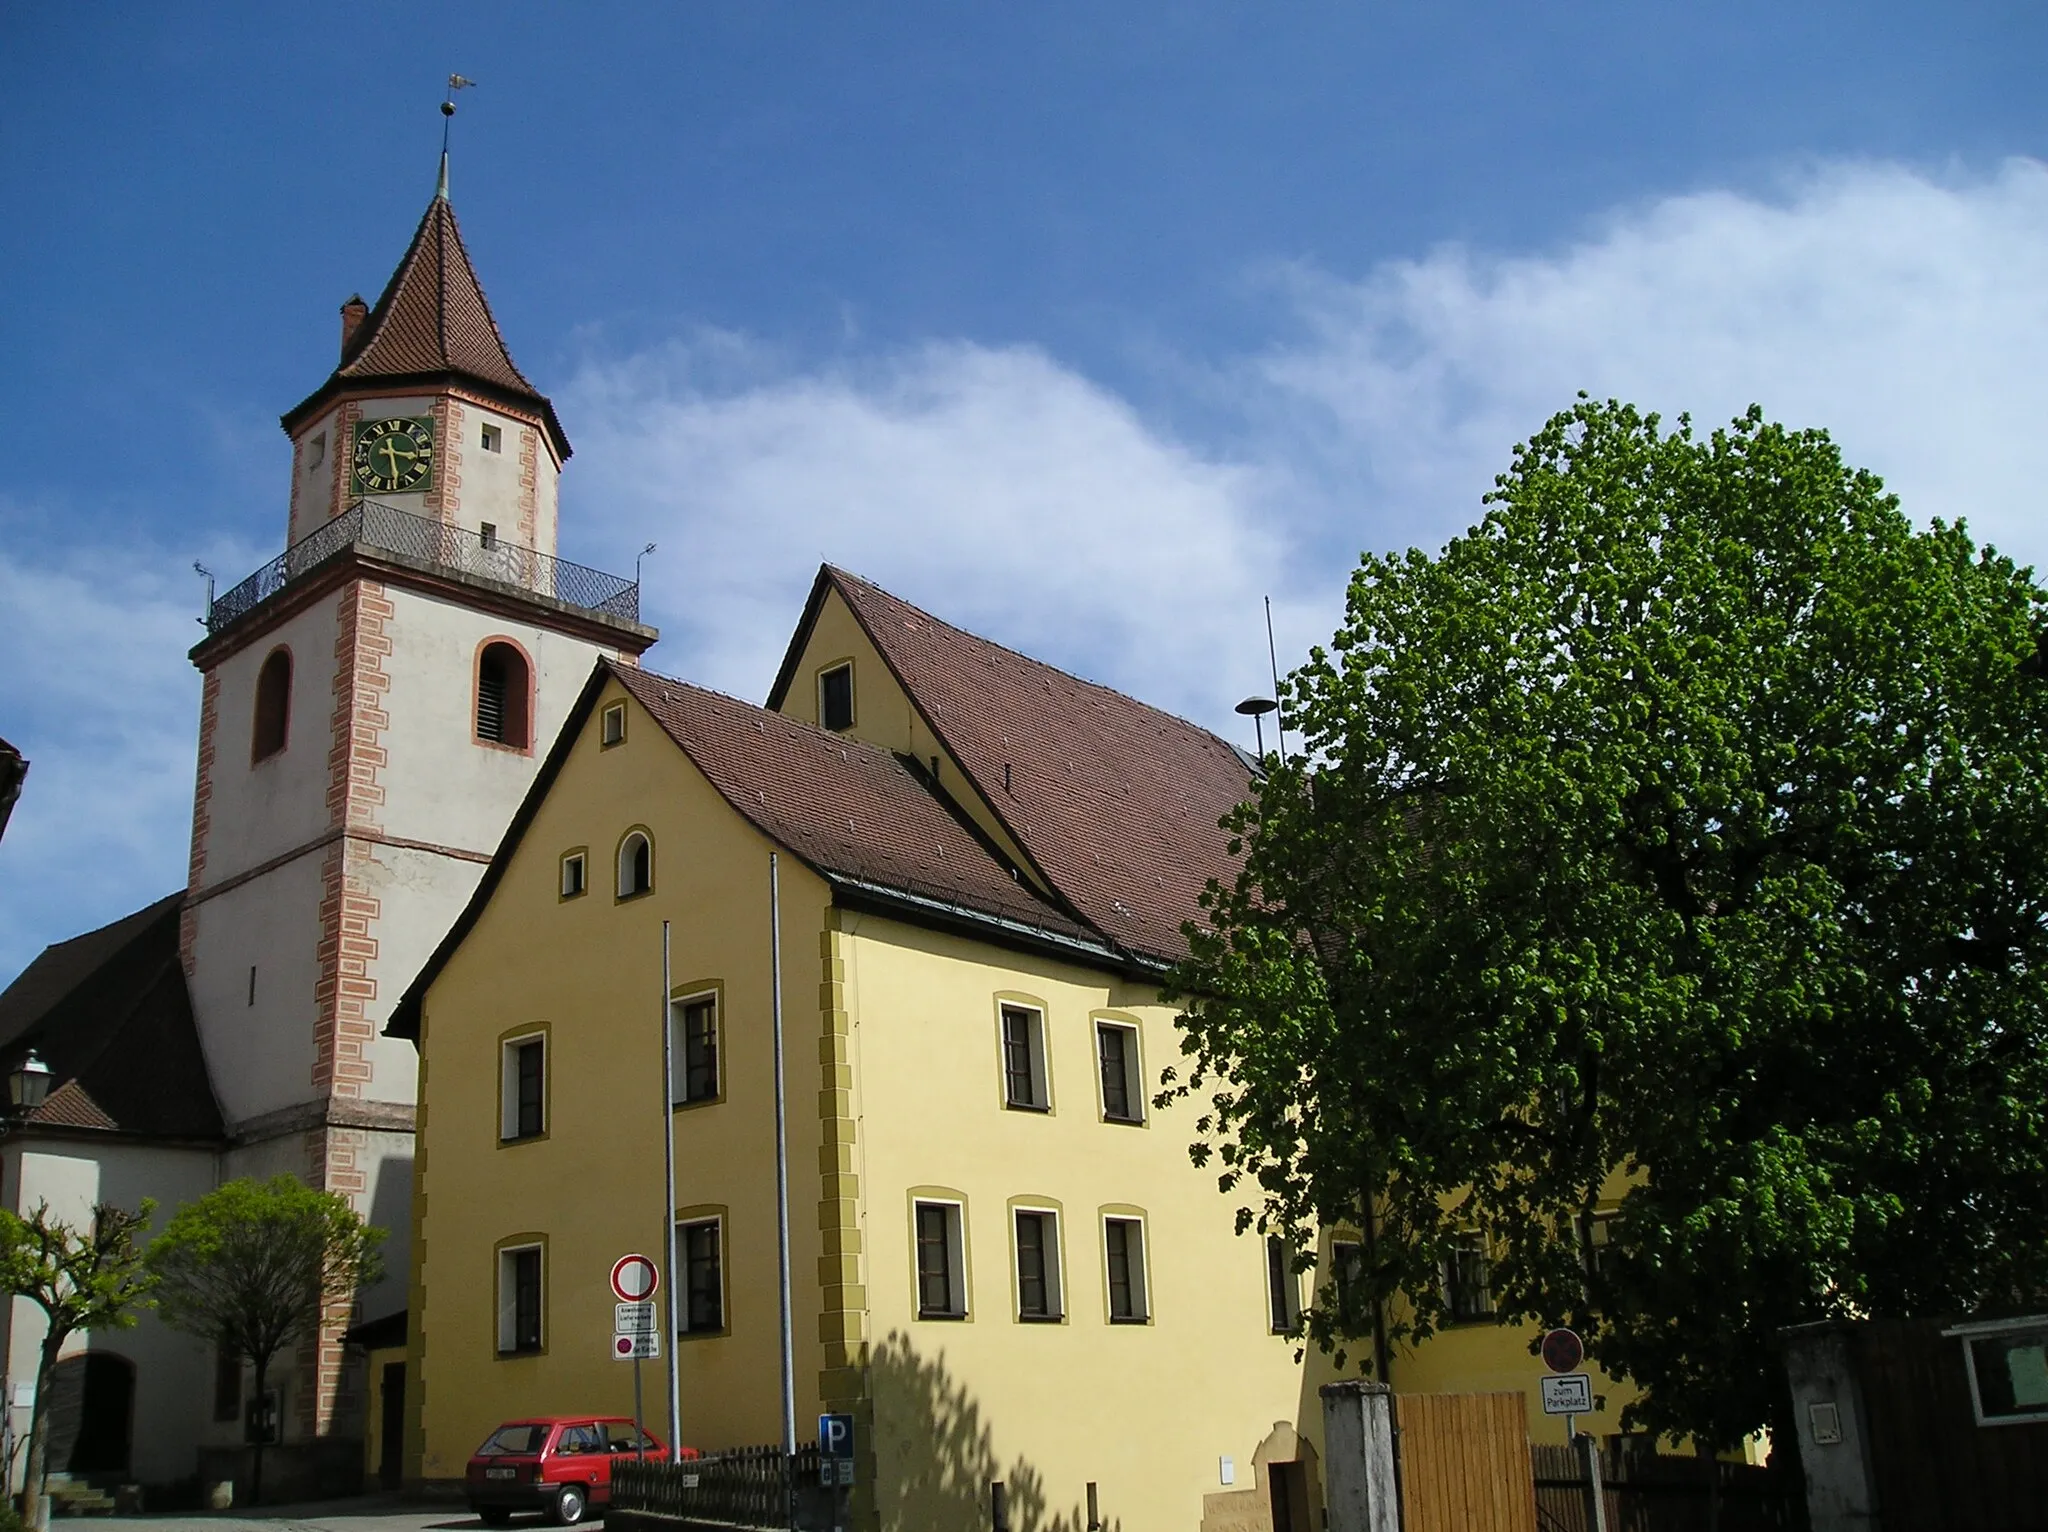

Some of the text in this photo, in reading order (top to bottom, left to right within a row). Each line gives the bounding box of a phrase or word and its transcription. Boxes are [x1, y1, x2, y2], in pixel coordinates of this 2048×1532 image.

[1553, 1387, 1573, 1396] zum
[1546, 1396, 1586, 1408] Parkplatz
[827, 1420, 846, 1452] P
